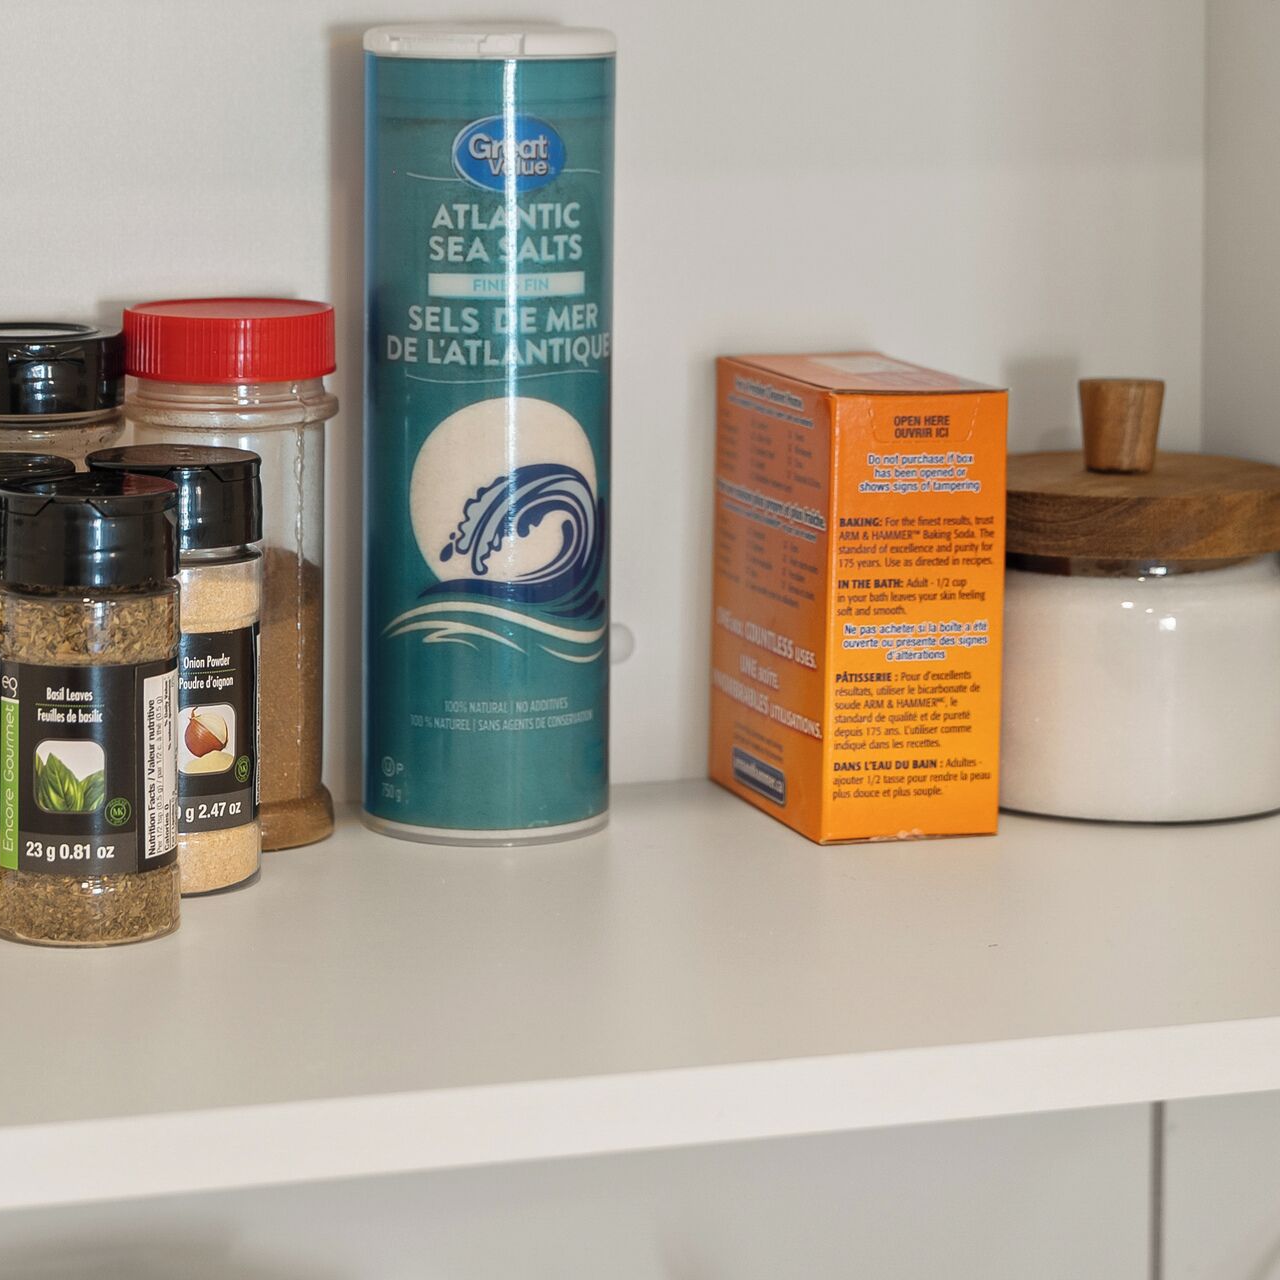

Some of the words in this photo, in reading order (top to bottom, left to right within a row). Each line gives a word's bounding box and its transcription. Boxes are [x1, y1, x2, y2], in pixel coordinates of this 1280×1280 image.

[468, 133, 549, 160] Grat
[488, 158, 549, 177] Vlue
[432, 202, 581, 231] ATLANTIC
[429, 236, 489, 262] SEA
[500, 234, 583, 262] SALTS
[524, 277, 549, 291] FIN
[408, 305, 479, 334] SELS
[494, 306, 537, 334] DE
[546, 303, 598, 331] MER
[387, 334, 418, 363] DE
[427, 332, 611, 367] L'ATLANTIQUE
[893, 415, 921, 427] OPEN
[924, 415, 950, 426] HERE
[894, 427, 932, 439] OUVRIR
[935, 427, 949, 438] ICI
[868, 454, 881, 465] Do
[883, 454, 899, 464] not
[901, 453, 944, 466] purchase
[946, 452, 955, 463] if
[956, 453, 972, 463] box
[874, 468, 891, 478] has
[894, 468, 916, 478] been
[920, 467, 954, 479] opened
[956, 468, 966, 477] or
[859, 481, 890, 492] shows
[892, 481, 918, 493] signs
[920, 480, 931, 491] of
[933, 480, 980, 493] tampering
[839, 517, 882, 528] BAKING:
[885, 517, 899, 527] For
[838, 530, 859, 541] ARM
[861, 531, 869, 540] &
[922, 529, 951, 541] Baking
[979, 528, 995, 538] The
[838, 544, 877, 555] standard
[878, 543, 888, 553] of
[890, 543, 934, 553] excellence
[935, 542, 951, 553] and
[954, 542, 979, 554] purity
[981, 542, 993, 552] for
[838, 558, 854, 568] 175
[884, 557, 900, 567] Use
[903, 558, 913, 567] as
[915, 556, 949, 567] directed
[951, 556, 960, 565] in
[837, 579, 849, 589] IN
[852, 578, 871, 589] THE
[873, 578, 904, 588] BATH:
[906, 577, 928, 588] Adult
[952, 579, 967, 589] cup
[837, 593, 846, 603] in
[848, 593, 867, 604] your
[869, 591, 888, 602] bath
[890, 591, 916, 601] leaves
[918, 591, 938, 603] your
[940, 590, 956, 600] skin
[958, 589, 985, 602] feeling
[837, 606, 853, 616] soft
[855, 606, 871, 616] and
[873, 605, 907, 616] smooth.
[183, 656, 205, 669] Onion
[206, 652, 231, 668] Powder
[178, 675, 205, 690] Poudre
[205, 674, 234, 691] d'oignon
[835, 671, 892, 683] PÂTISSERIE
[900, 671, 921, 681] Pour
[46, 686, 65, 701] Basil
[66, 687, 93, 702] Leaves
[37, 708, 65, 723] Feuilles
[66, 708, 77, 723] de
[78, 707, 103, 723] basilic
[469, 701, 509, 714] NATURAL
[515, 701, 528, 713] NO
[147, 699, 155, 741] nutritive
[478, 719, 500, 732] SANS
[3, 704, 14, 782] Gourmet
[147, 744, 155, 776] Valeur
[833, 760, 861, 772] DANS
[864, 760, 892, 770] L'EAU
[895, 759, 910, 770] DU
[912, 759, 937, 769] BAIN
[945, 758, 977, 768] Adultes
[185, 807, 195, 823] g
[198, 801, 227, 819] 2.47
[228, 801, 242, 815] oz
[3, 788, 15, 852] Encore
[148, 812, 156, 856] Nutrition
[26, 841, 43, 858] 23
[46, 846, 56, 862] g
[59, 843, 91, 860] 0.81
[96, 846, 115, 859] oz
